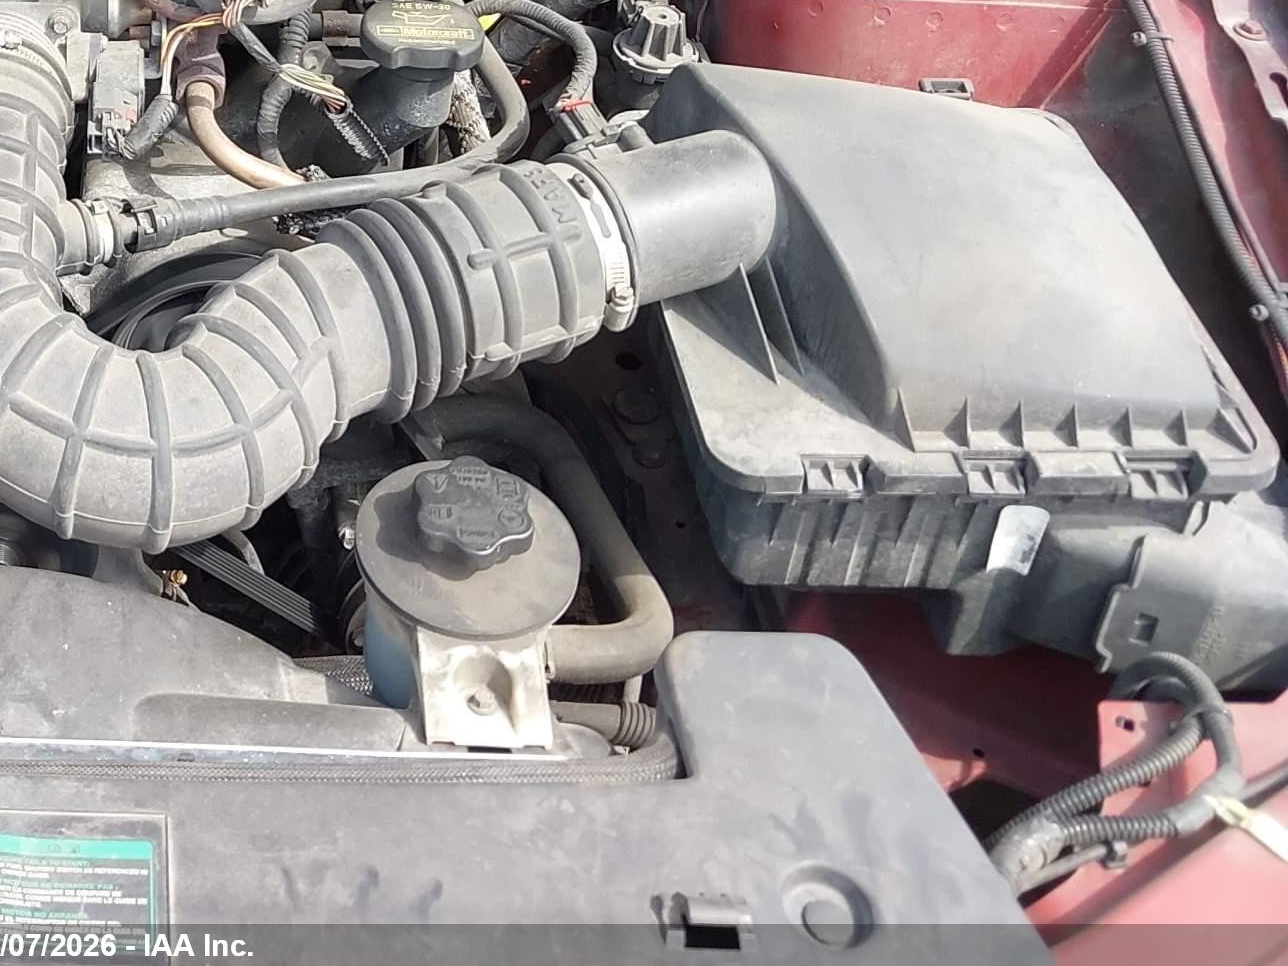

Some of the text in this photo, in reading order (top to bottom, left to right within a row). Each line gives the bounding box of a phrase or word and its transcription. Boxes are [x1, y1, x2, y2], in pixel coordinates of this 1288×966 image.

[392, 2, 452, 11] SAE 5W-30
[402, 27, 469, 39] Motorcraft
